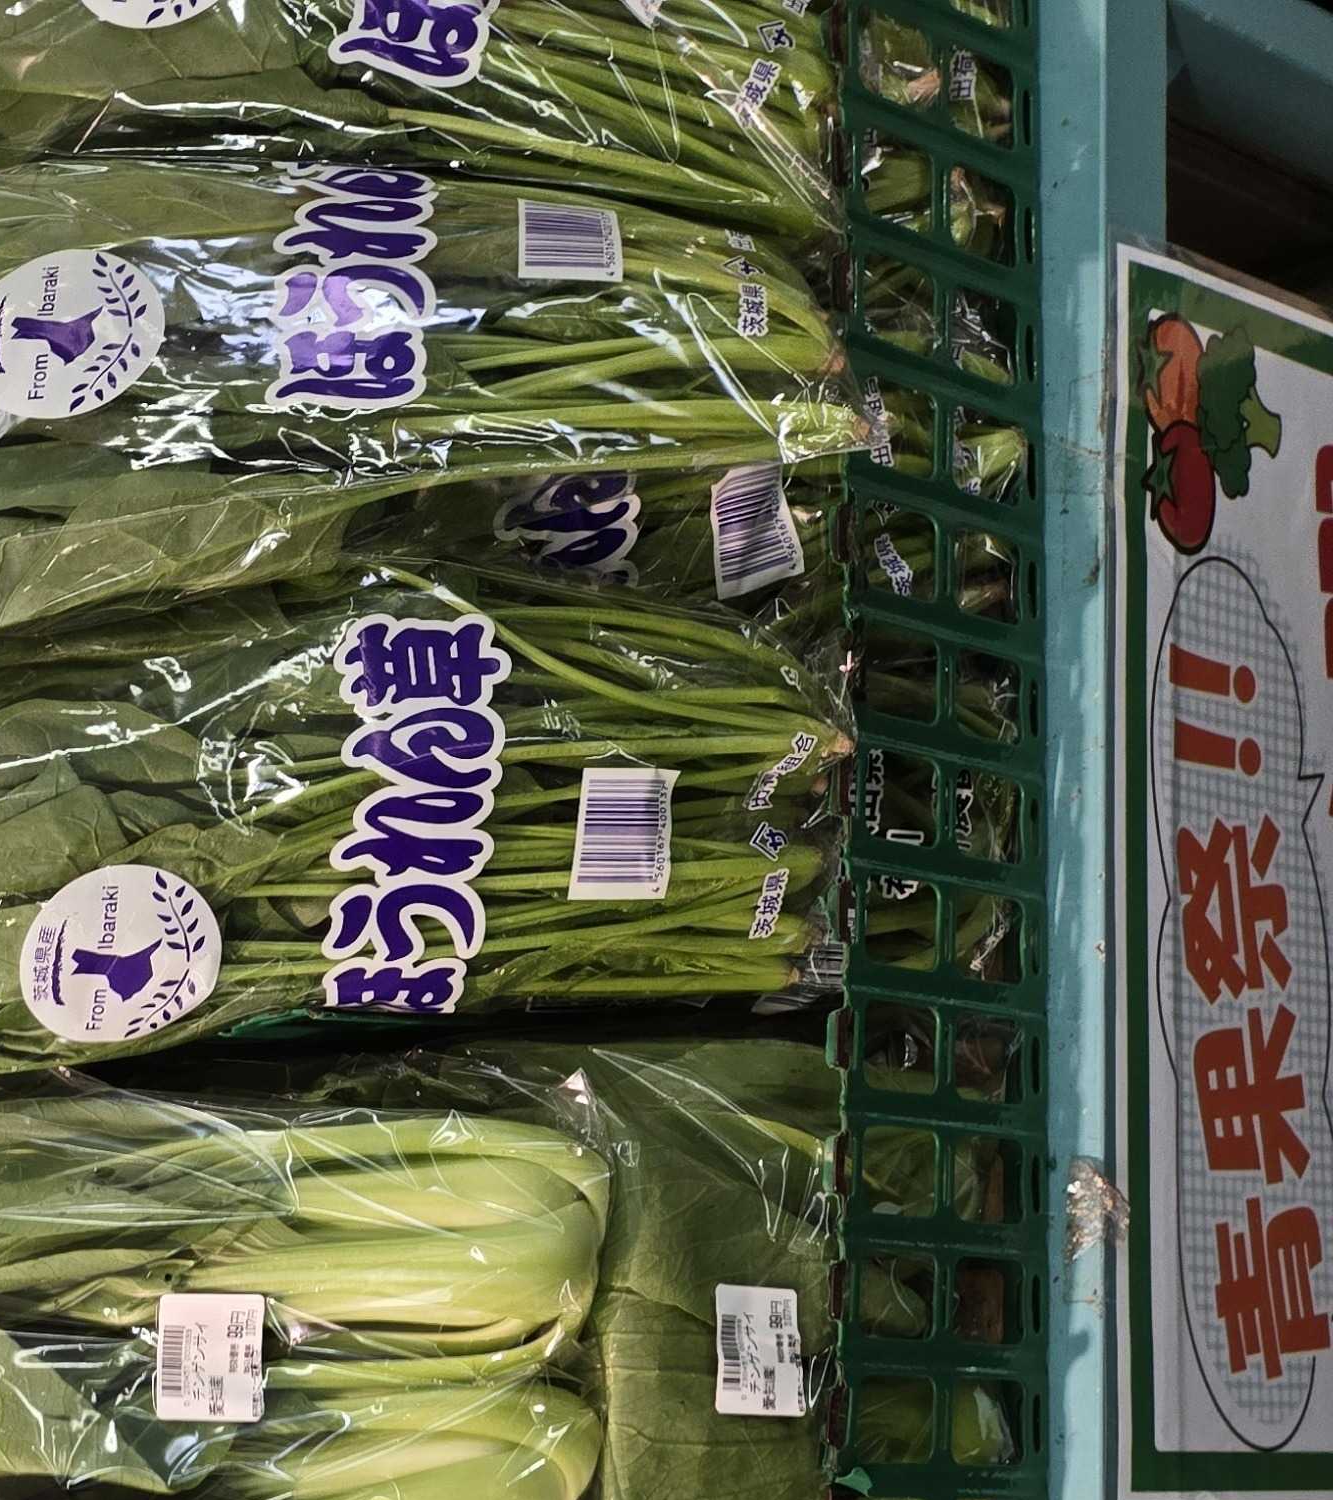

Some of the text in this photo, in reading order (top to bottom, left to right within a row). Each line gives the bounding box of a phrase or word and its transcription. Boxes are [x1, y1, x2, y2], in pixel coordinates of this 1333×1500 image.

[28, 265, 60, 400] From Ibaraki
[741, 283, 767, 335] 茨城県
[874, 535, 912, 595] 茨城県
[332, 622, 499, 1012] ほうれん草
[654, 835, 666, 879] 560167
[753, 869, 788, 937] 茨城県
[33, 924, 57, 1001] 茨城県産
[85, 884, 120, 1031] From Ibaraki
